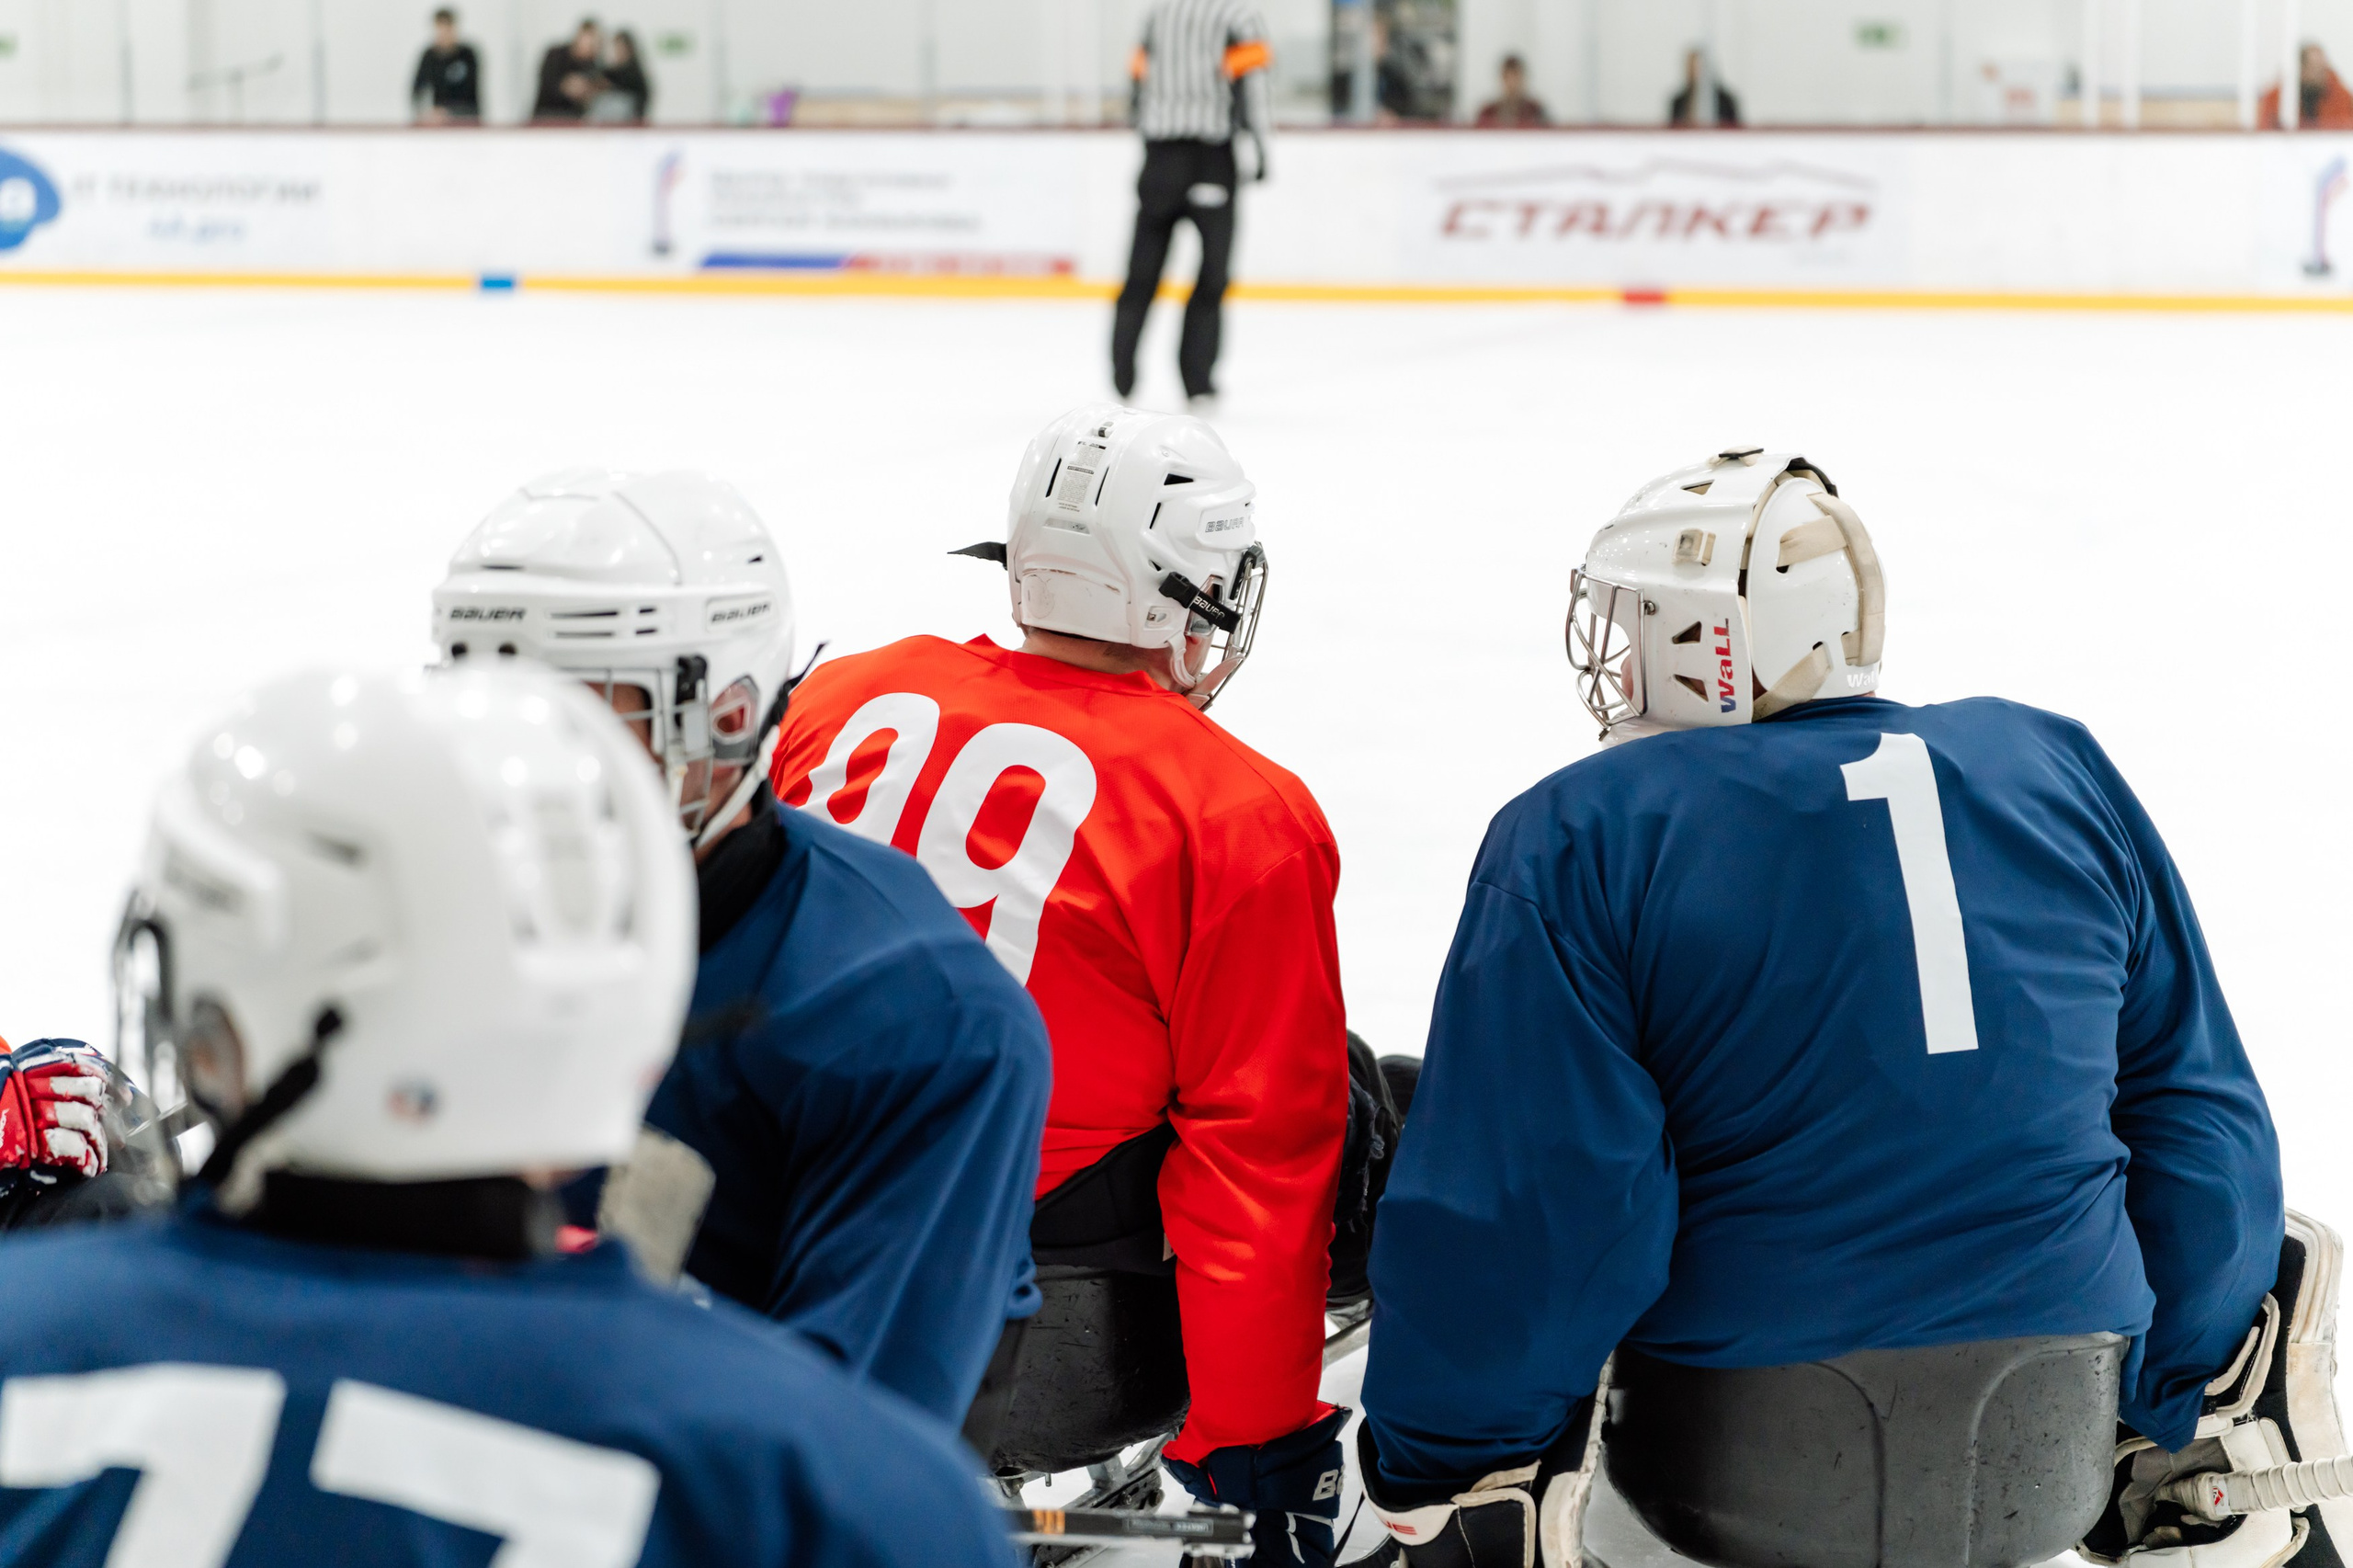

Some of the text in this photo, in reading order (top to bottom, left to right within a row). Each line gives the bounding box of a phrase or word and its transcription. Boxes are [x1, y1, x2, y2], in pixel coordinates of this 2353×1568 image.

[1439, 198, 1873, 242] СТАЛКЕР
[794, 691, 1098, 989] 99
[1839, 732, 1980, 1055] 1
[0, 1361, 661, 1568] 77
